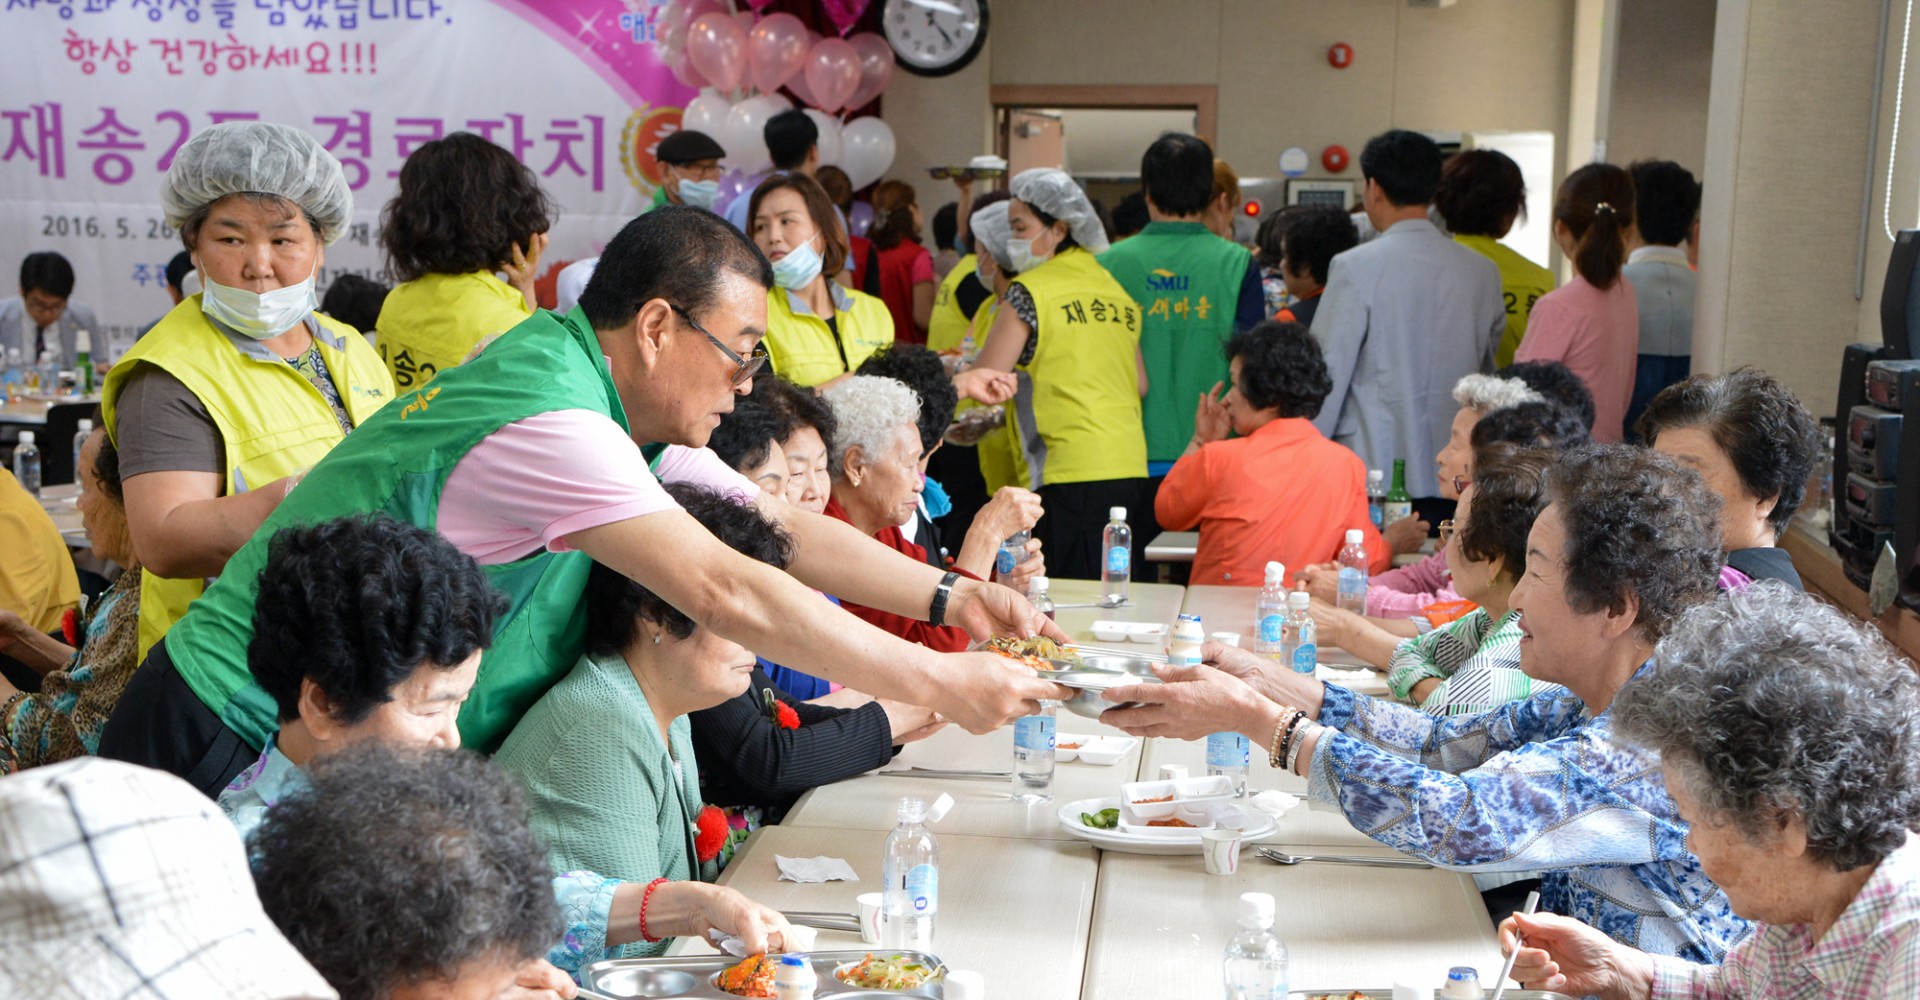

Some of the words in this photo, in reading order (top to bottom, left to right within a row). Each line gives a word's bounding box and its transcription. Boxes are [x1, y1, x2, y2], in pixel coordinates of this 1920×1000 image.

[62, 28, 138, 75] 항상
[149, 32, 378, 76] 건강하세요!!!
[1, 101, 260, 186] 재송2
[42, 215, 106, 239] 2016.
[117, 218, 136, 239] 5.
[1146, 274, 1189, 291] SMU
[1061, 298, 1136, 332] 재송2동
[1148, 296, 1213, 321] 새마을
